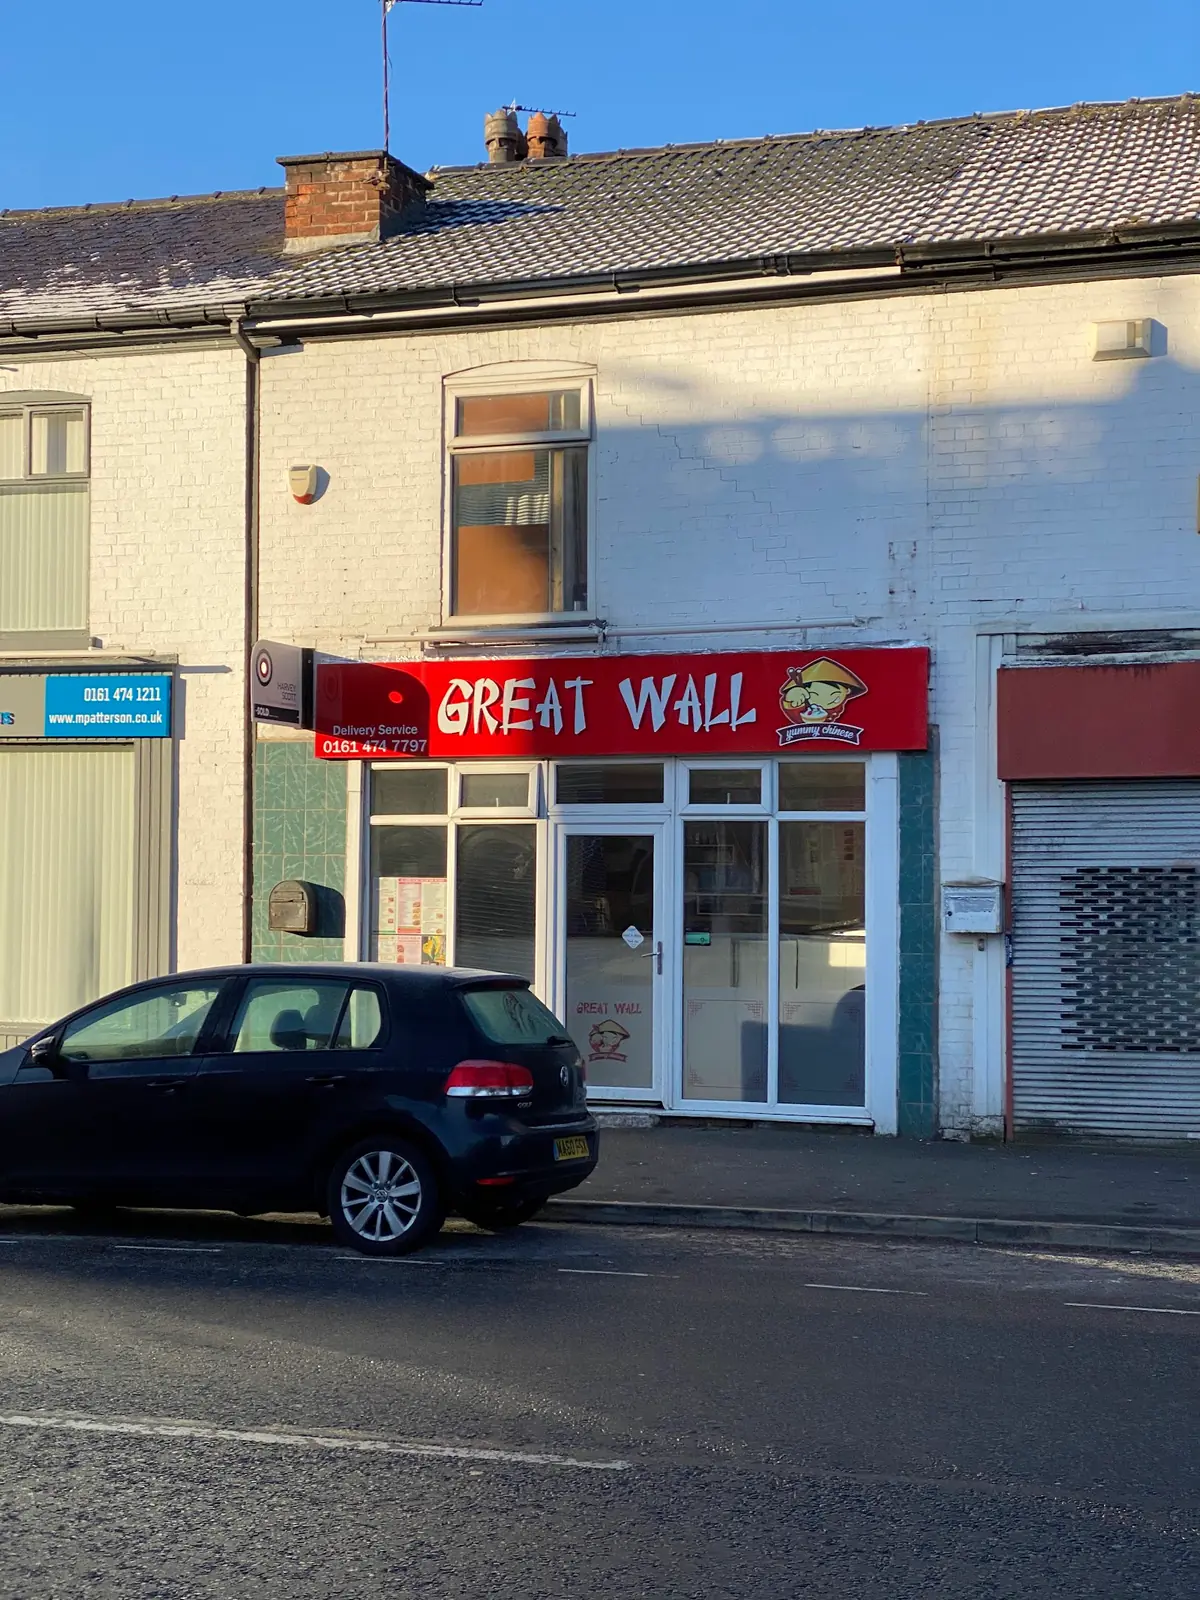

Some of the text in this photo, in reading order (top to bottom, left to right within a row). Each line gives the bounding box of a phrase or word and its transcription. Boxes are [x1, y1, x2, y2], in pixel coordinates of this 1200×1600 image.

[84, 687, 161, 702] 0161 474 1211
[437, 672, 756, 735] GREAT WALL
[49, 710, 162, 726] www.mpatterson.co.uk
[333, 724, 418, 737] Delivery Service
[785, 724, 854, 742] yummy chinese
[323, 739, 428, 753] 0161 474 7797
[576, 1002, 642, 1014] GREAT WALL
